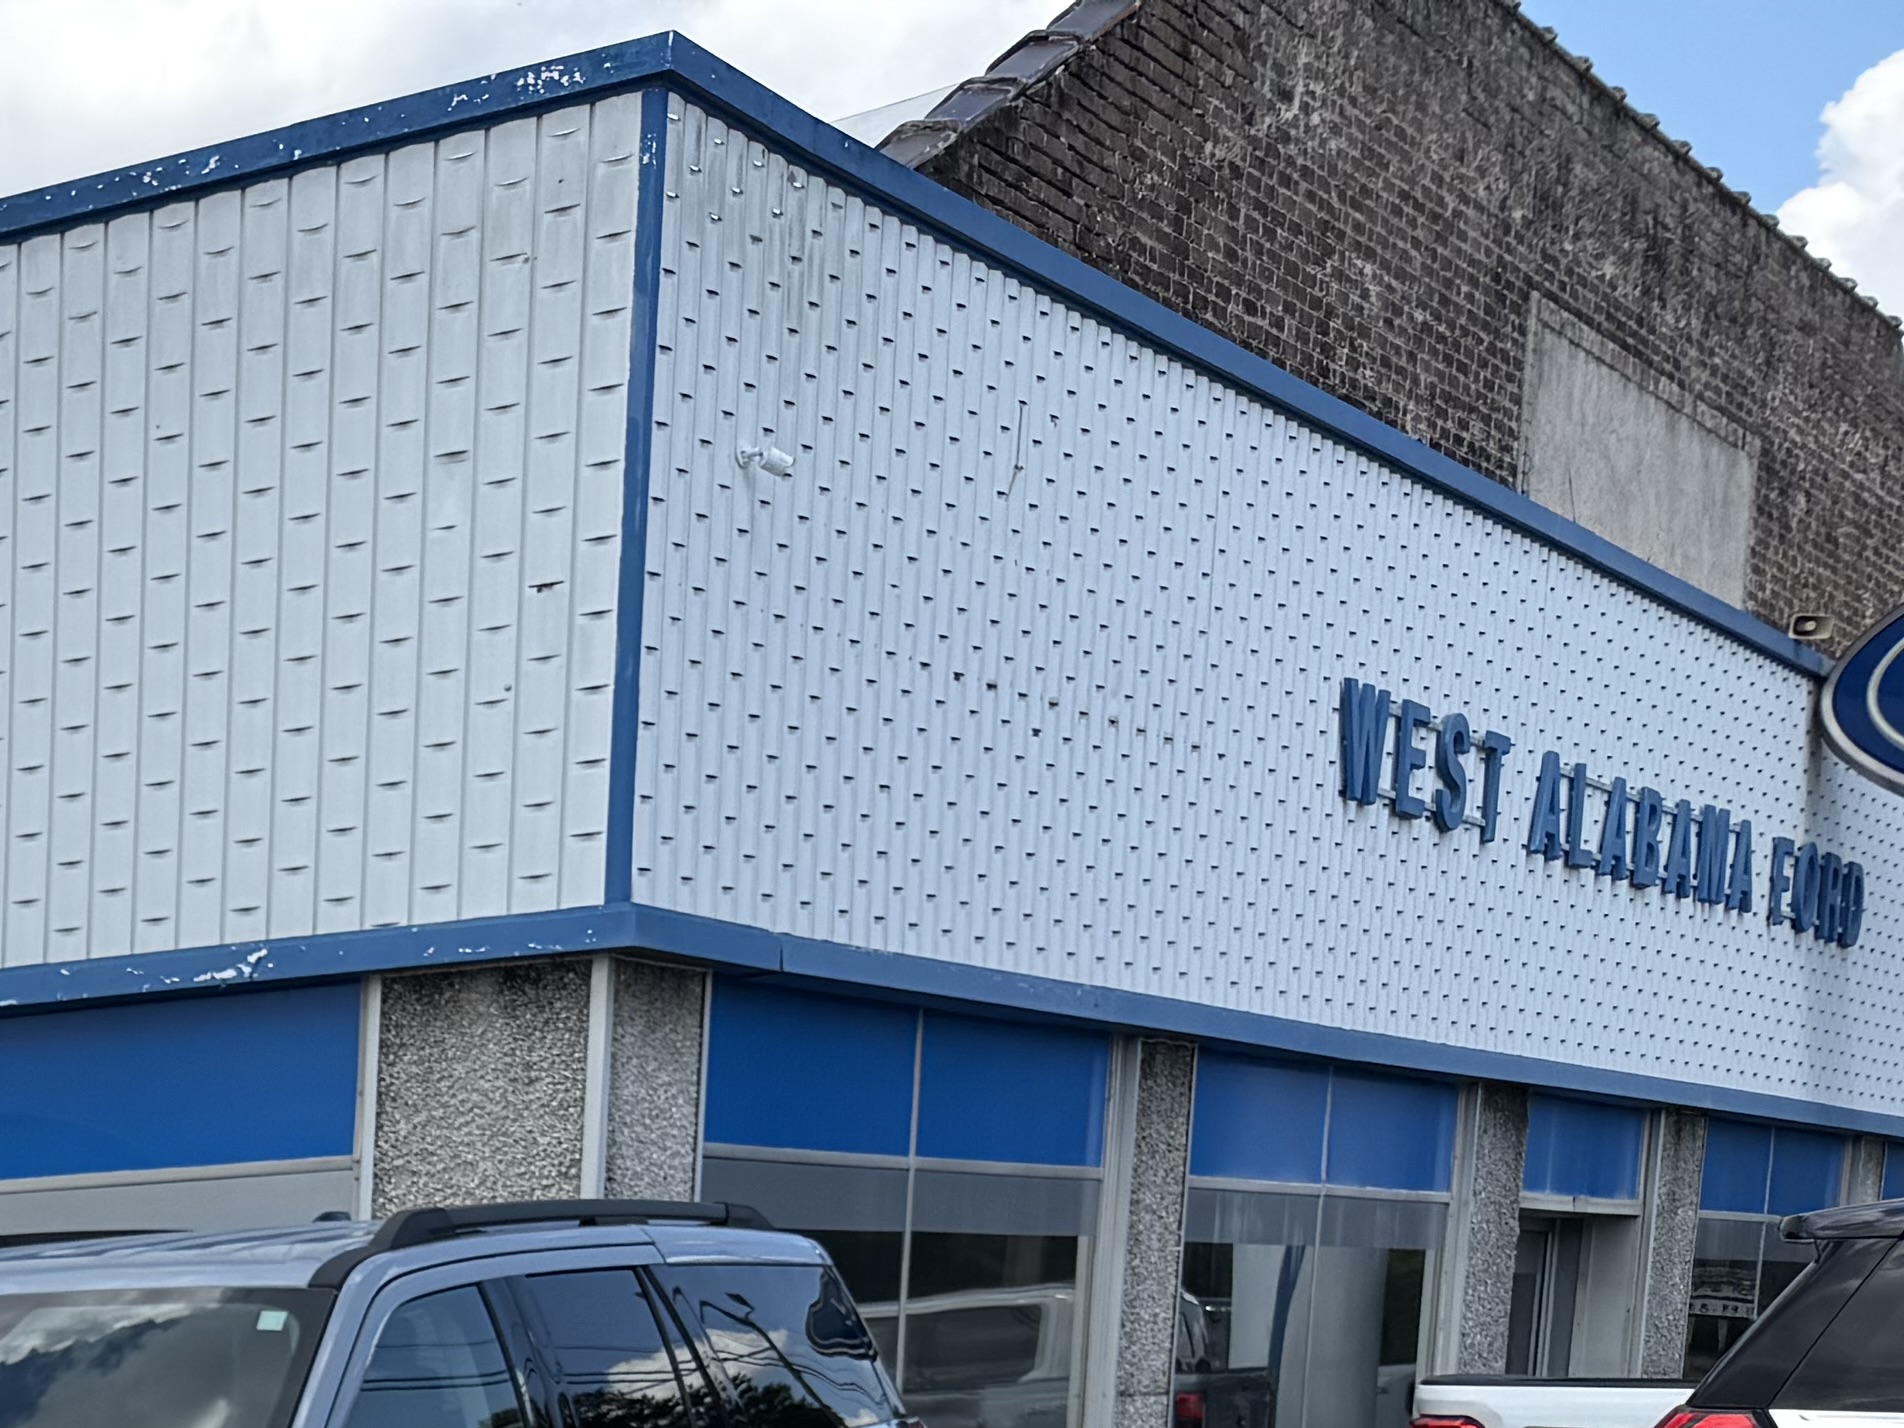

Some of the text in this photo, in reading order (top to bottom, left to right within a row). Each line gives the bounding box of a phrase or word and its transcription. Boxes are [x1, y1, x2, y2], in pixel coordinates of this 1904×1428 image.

[1339, 677, 1866, 949] WEST ALABAMA FORD
